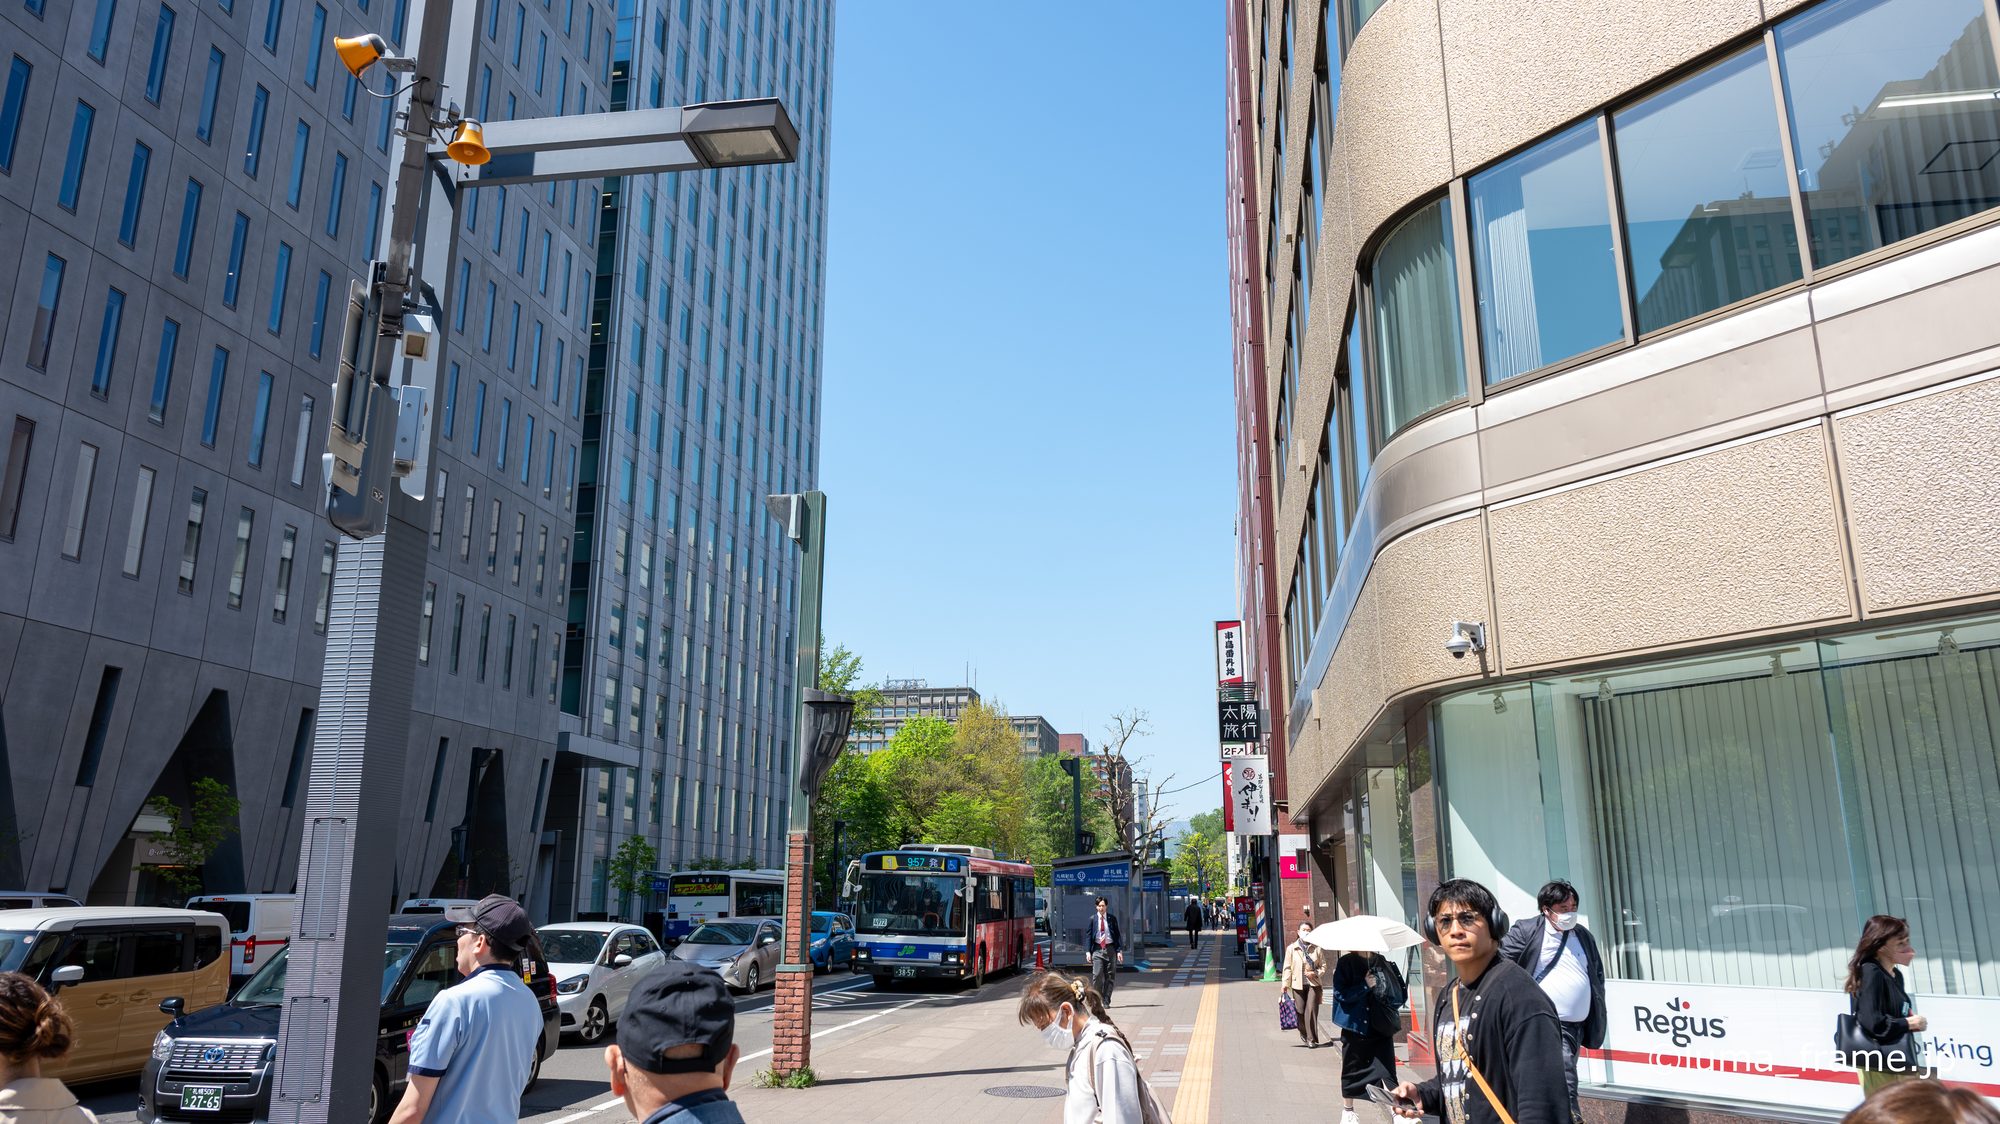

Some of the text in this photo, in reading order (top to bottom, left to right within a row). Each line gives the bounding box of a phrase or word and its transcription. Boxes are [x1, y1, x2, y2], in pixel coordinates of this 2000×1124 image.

[1222, 704, 1257, 720] 太陽
[1223, 722, 1257, 738] 旅行
[1224, 747, 1237, 755] 2F
[907, 857, 925, 867] 9:57
[1634, 998, 1726, 1048] Regus
[190, 1095, 220, 1108] 27-65
